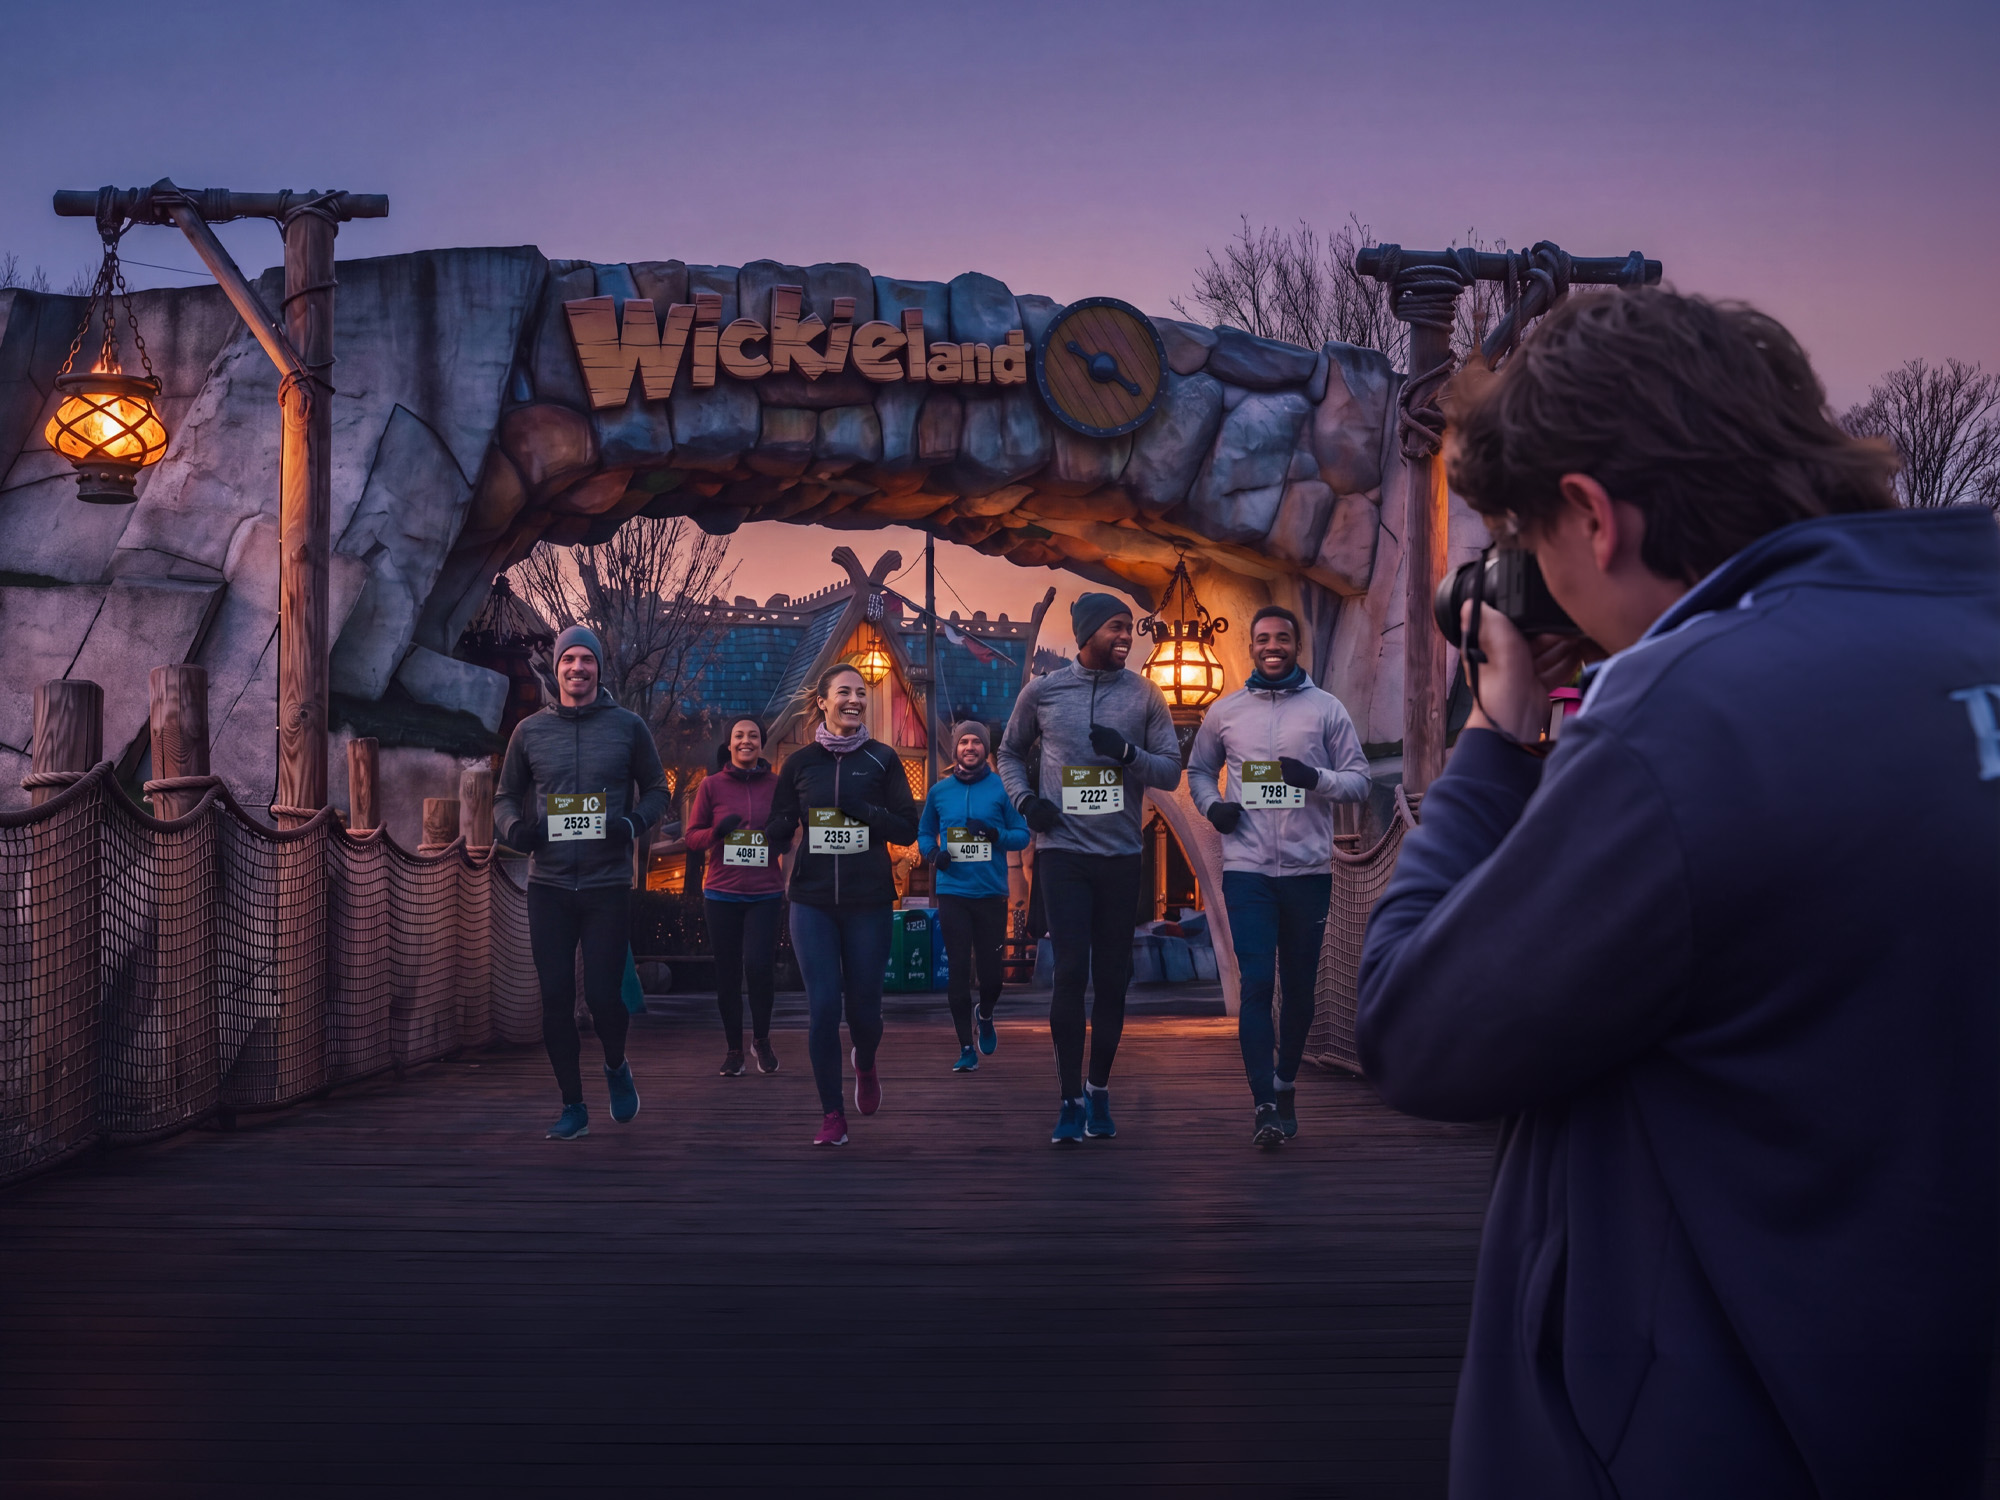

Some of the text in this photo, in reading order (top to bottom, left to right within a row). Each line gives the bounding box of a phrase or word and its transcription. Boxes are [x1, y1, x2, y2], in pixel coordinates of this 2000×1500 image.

[564, 284, 1028, 410] Wickieland
[1098, 769, 1116, 785] 10
[1080, 789, 1108, 803] 2222
[1261, 785, 1287, 798] 7981
[582, 796, 600, 812] 10
[564, 816, 590, 830] 2523
[824, 830, 851, 844] 2353
[736, 847, 756, 859] 4081
[960, 844, 979, 855] 4001
